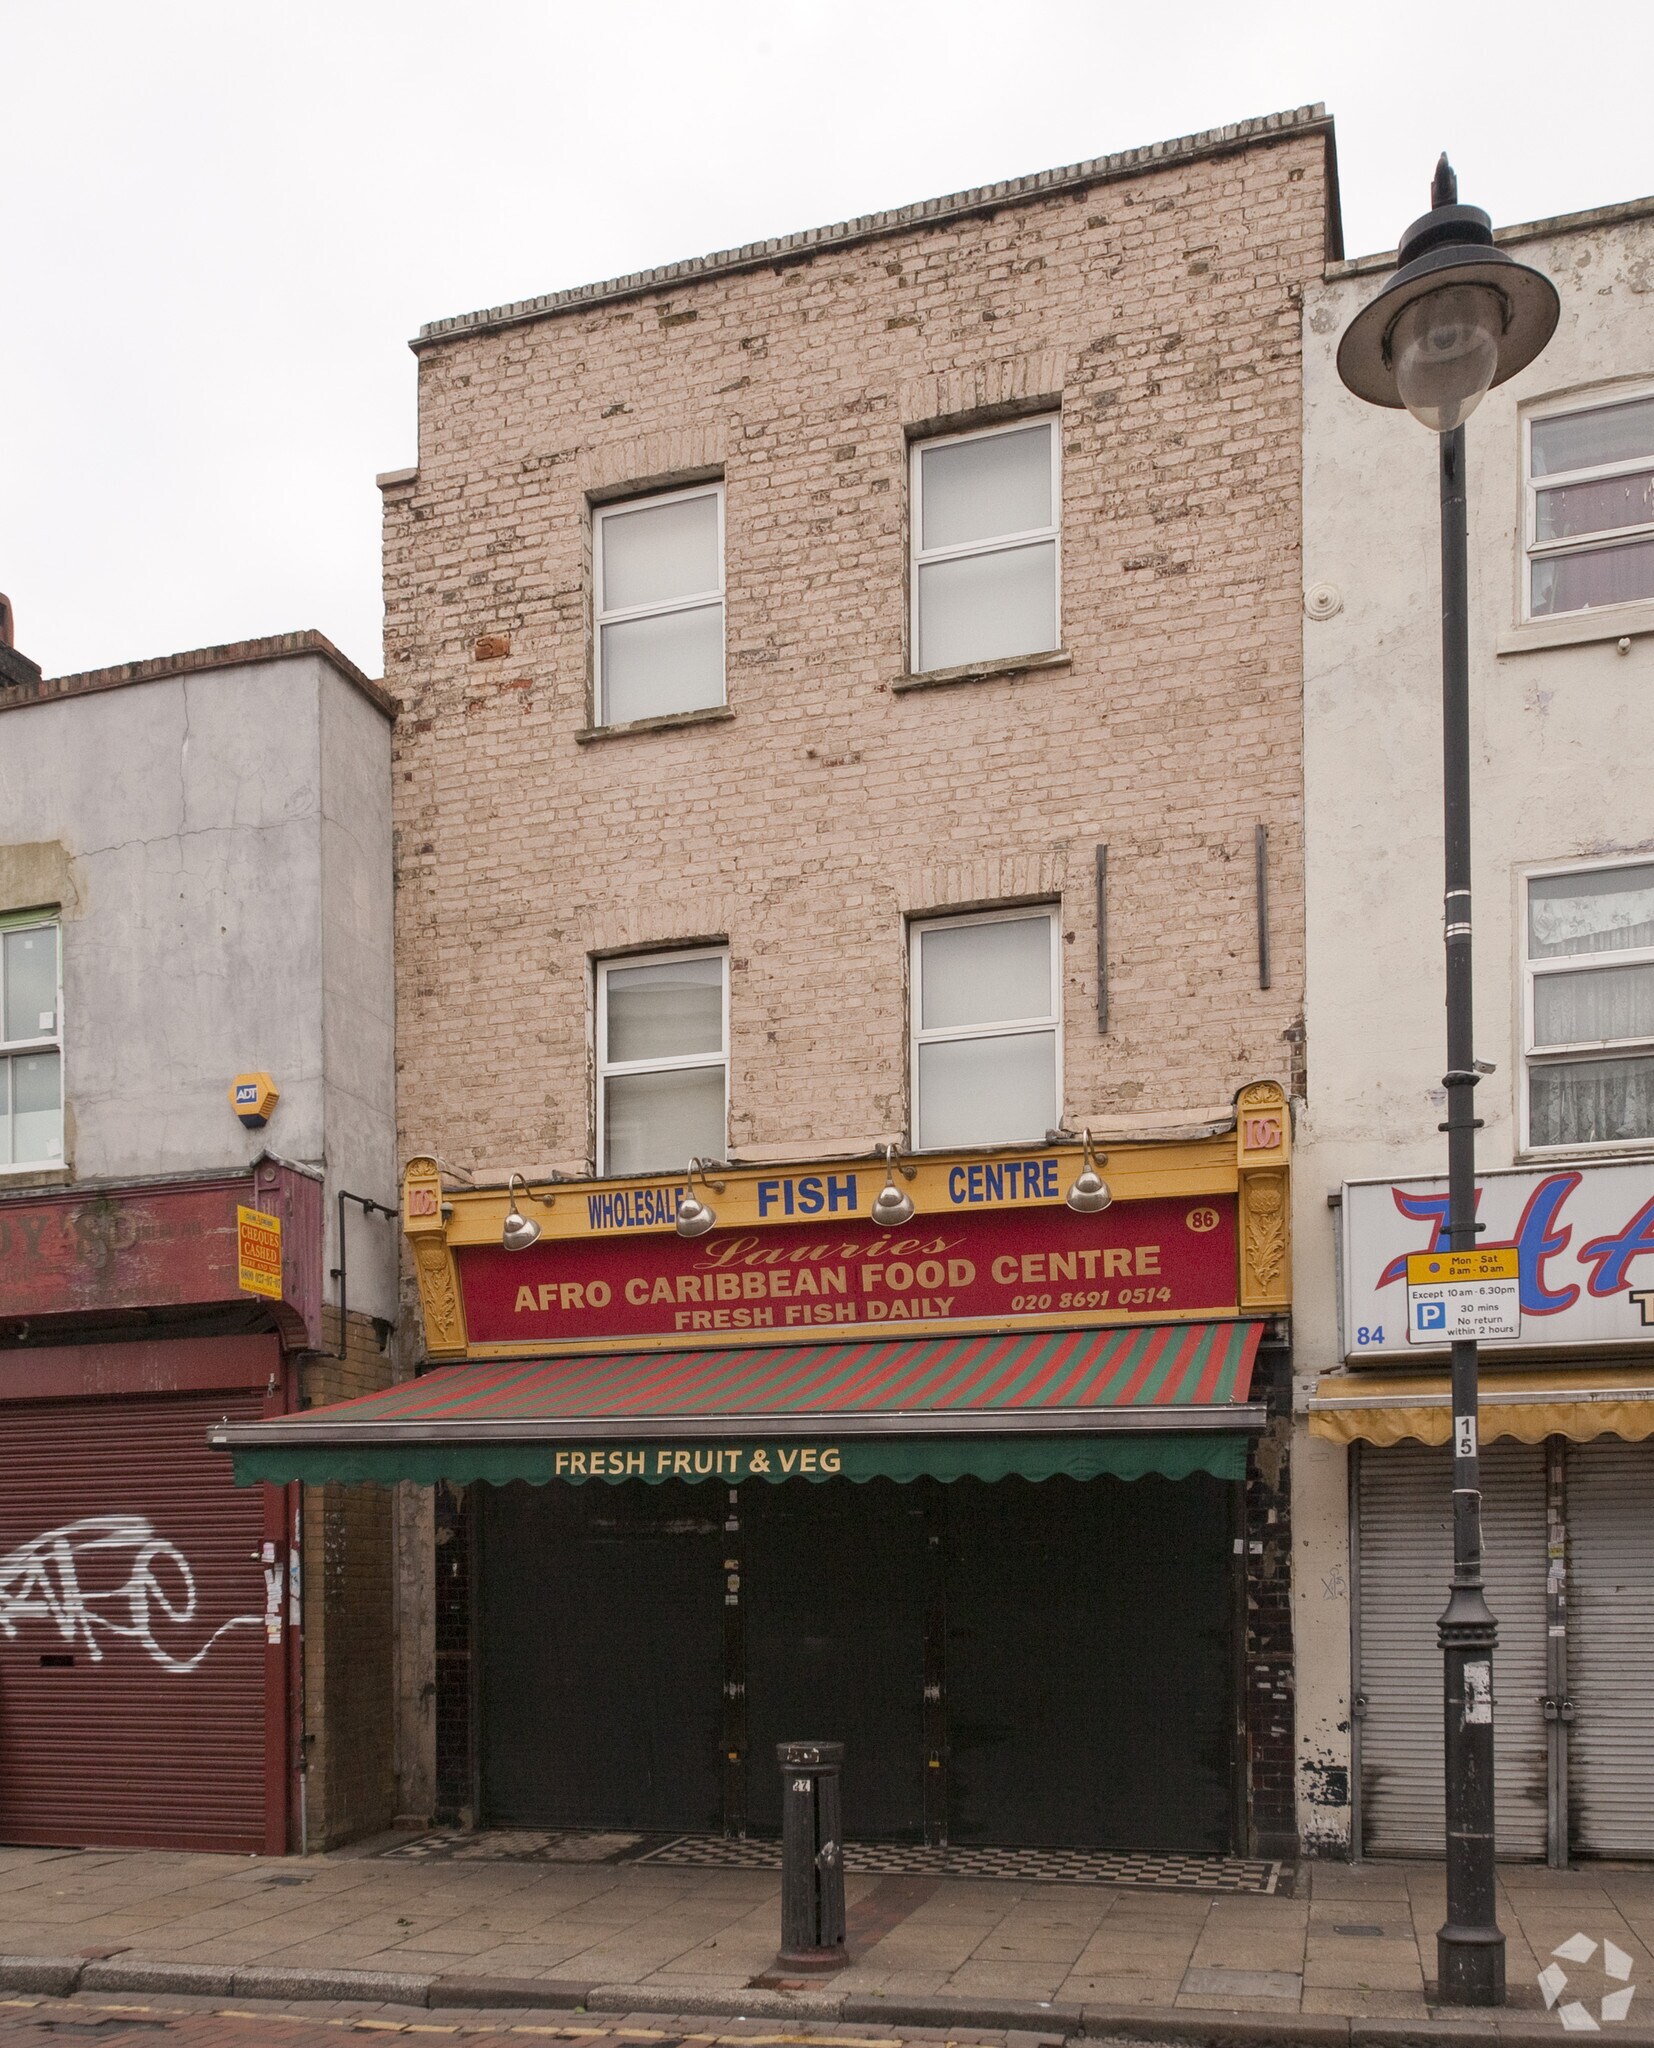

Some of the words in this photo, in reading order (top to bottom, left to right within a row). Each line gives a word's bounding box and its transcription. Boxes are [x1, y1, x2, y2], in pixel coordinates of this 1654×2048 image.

[236, 1087, 257, 1101] ADT
[757, 1174, 857, 1217] FISH
[949, 1159, 1059, 1204] CENTRE
[1192, 1210, 1214, 1228] 86
[241, 1225, 279, 1248] CHEQUES
[244, 1241, 277, 1262] CASHED
[1451, 1257, 1471, 1265] Mon
[1481, 1255, 1498, 1263] Sat
[514, 1280, 612, 1312] AFRO
[624, 1266, 848, 1306] CARIBBEAN
[861, 1258, 976, 1292] FOOD
[991, 1245, 1161, 1285] CENTRE
[1412, 1290, 1443, 1300] Except
[674, 1306, 774, 1330] FRESH
[785, 1302, 856, 1325] FISH
[867, 1296, 955, 1320] DAILY
[1011, 1294, 1052, 1311] 020
[1059, 1290, 1110, 1308] 8691
[1118, 1286, 1171, 1305] 0514
[1422, 1305, 1440, 1327] P
[1460, 1304, 1474, 1313] 30
[1477, 1303, 1499, 1312] mins
[1447, 1327, 1476, 1336] within
[1489, 1325, 1514, 1333] hours
[1457, 1317, 1471, 1325] No
[1474, 1316, 1503, 1324] return
[1357, 1325, 1385, 1345] 84
[555, 1451, 646, 1475] FRESH
[656, 1450, 743, 1474] FRUIT
[749, 1449, 771, 1473] &
[777, 1448, 841, 1473] VEG
